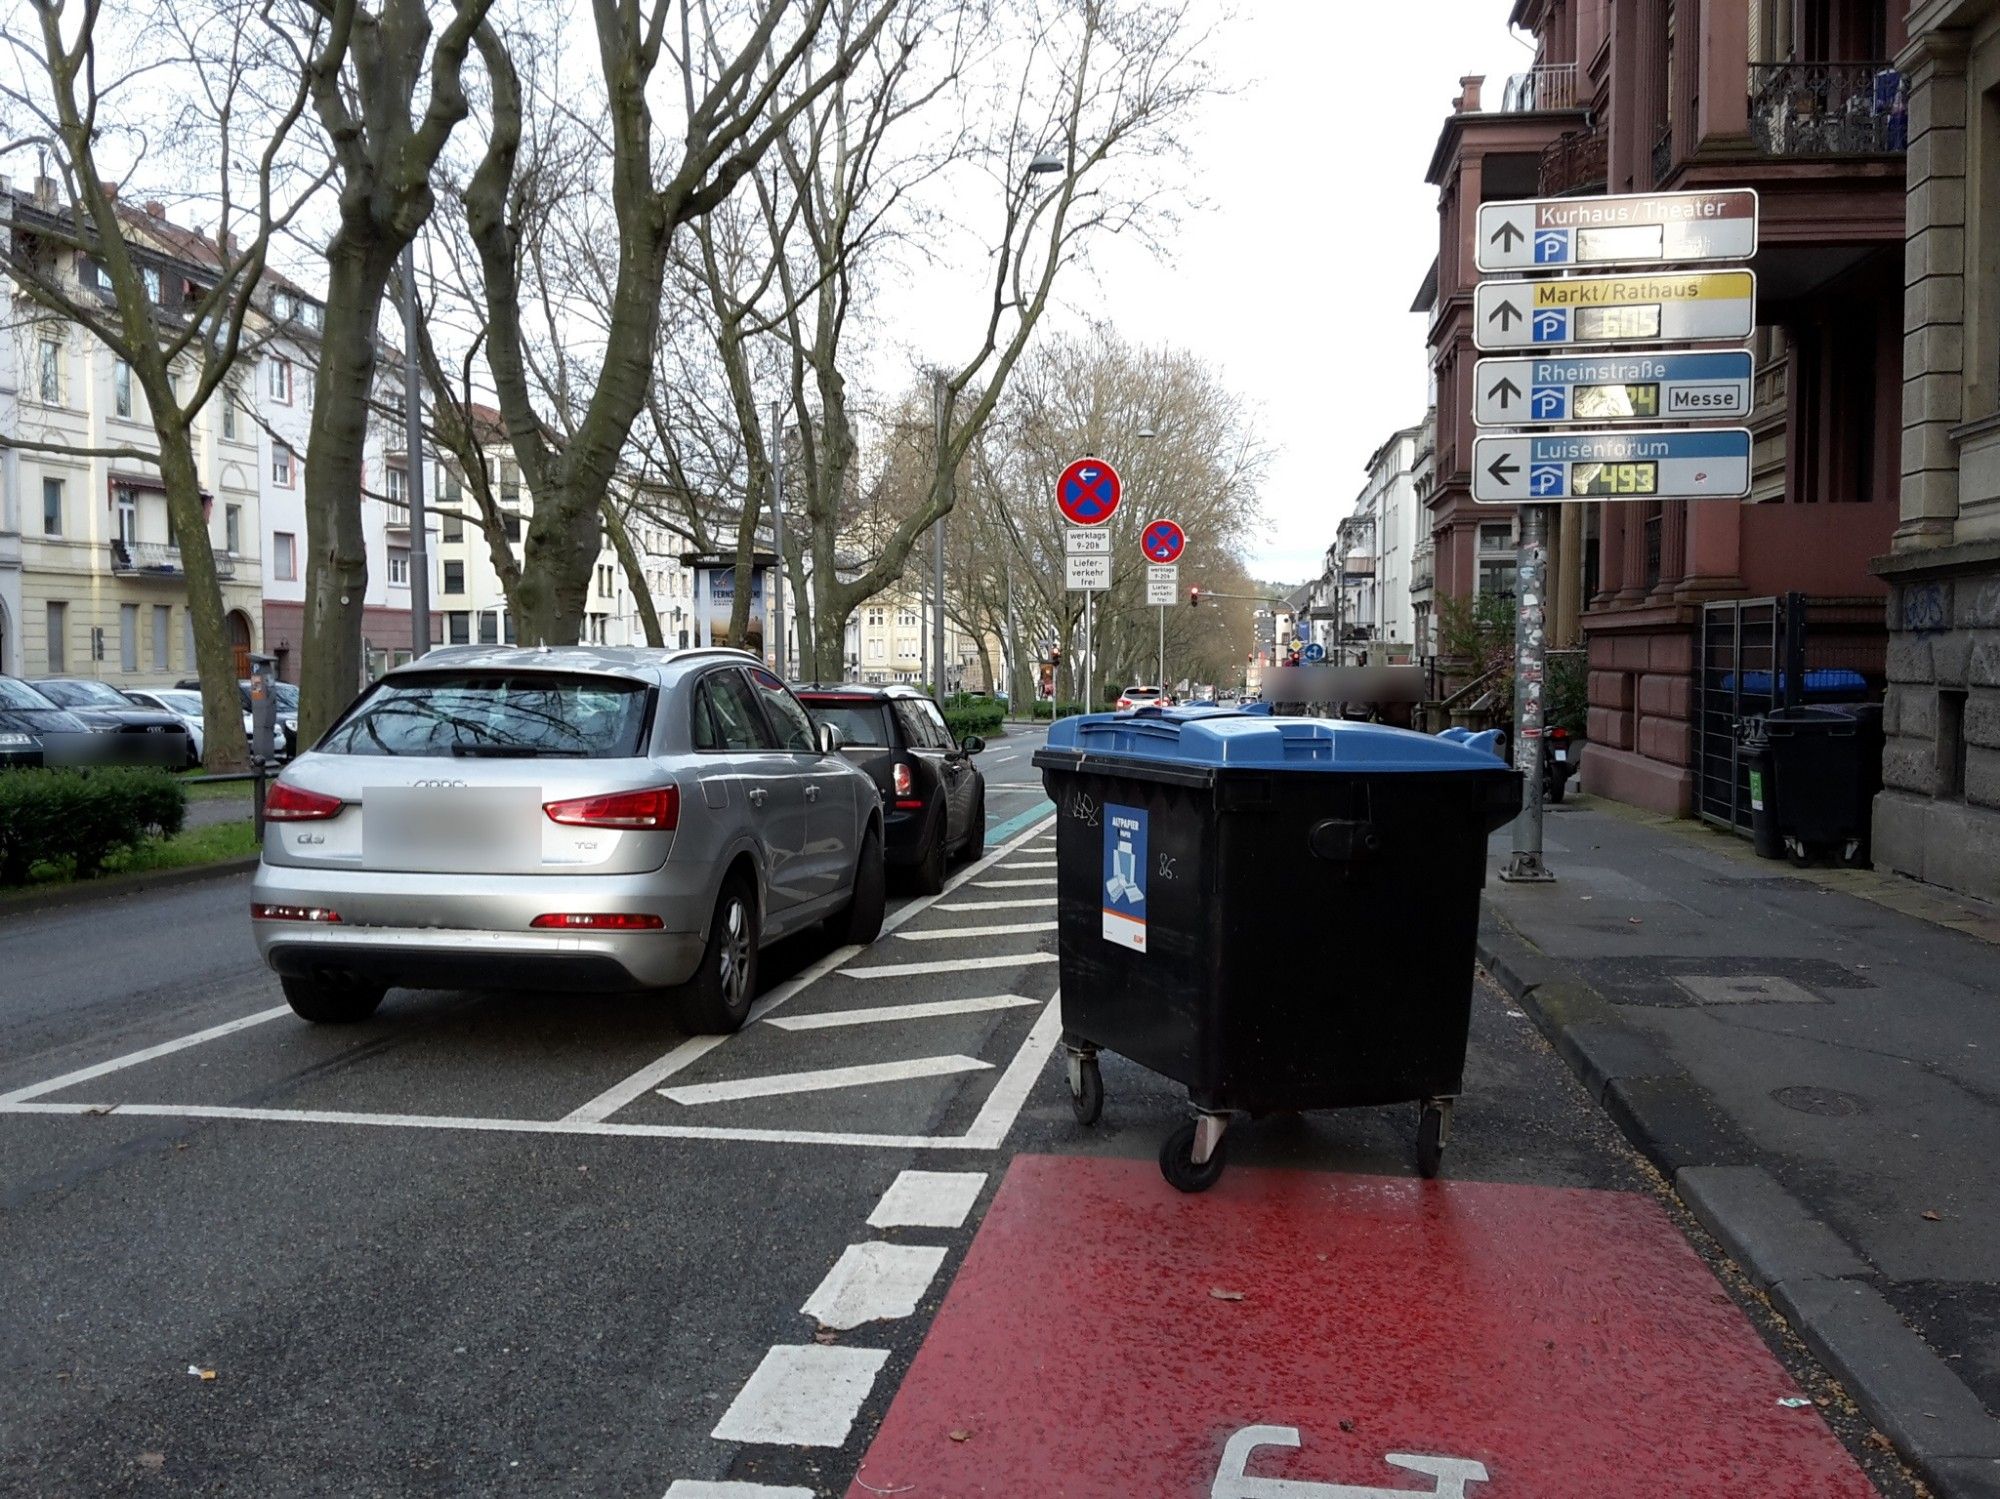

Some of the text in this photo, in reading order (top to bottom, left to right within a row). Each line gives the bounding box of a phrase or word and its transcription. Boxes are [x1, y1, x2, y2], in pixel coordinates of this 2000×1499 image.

[1544, 241, 1559, 261] P
[1543, 319, 1558, 340] P
[1538, 361, 1666, 382] Rheinstraße
[1541, 397, 1557, 418] P
[1674, 392, 1734, 407] Messe
[1537, 441, 1669, 460] Luisenforum
[1540, 475, 1556, 495] P
[1600, 464, 1655, 493] 493
[1070, 531, 1106, 540] werktags
[1072, 568, 1104, 576] verkehr
[1074, 559, 1102, 567] Liefer-
[1081, 577, 1095, 586] frei
